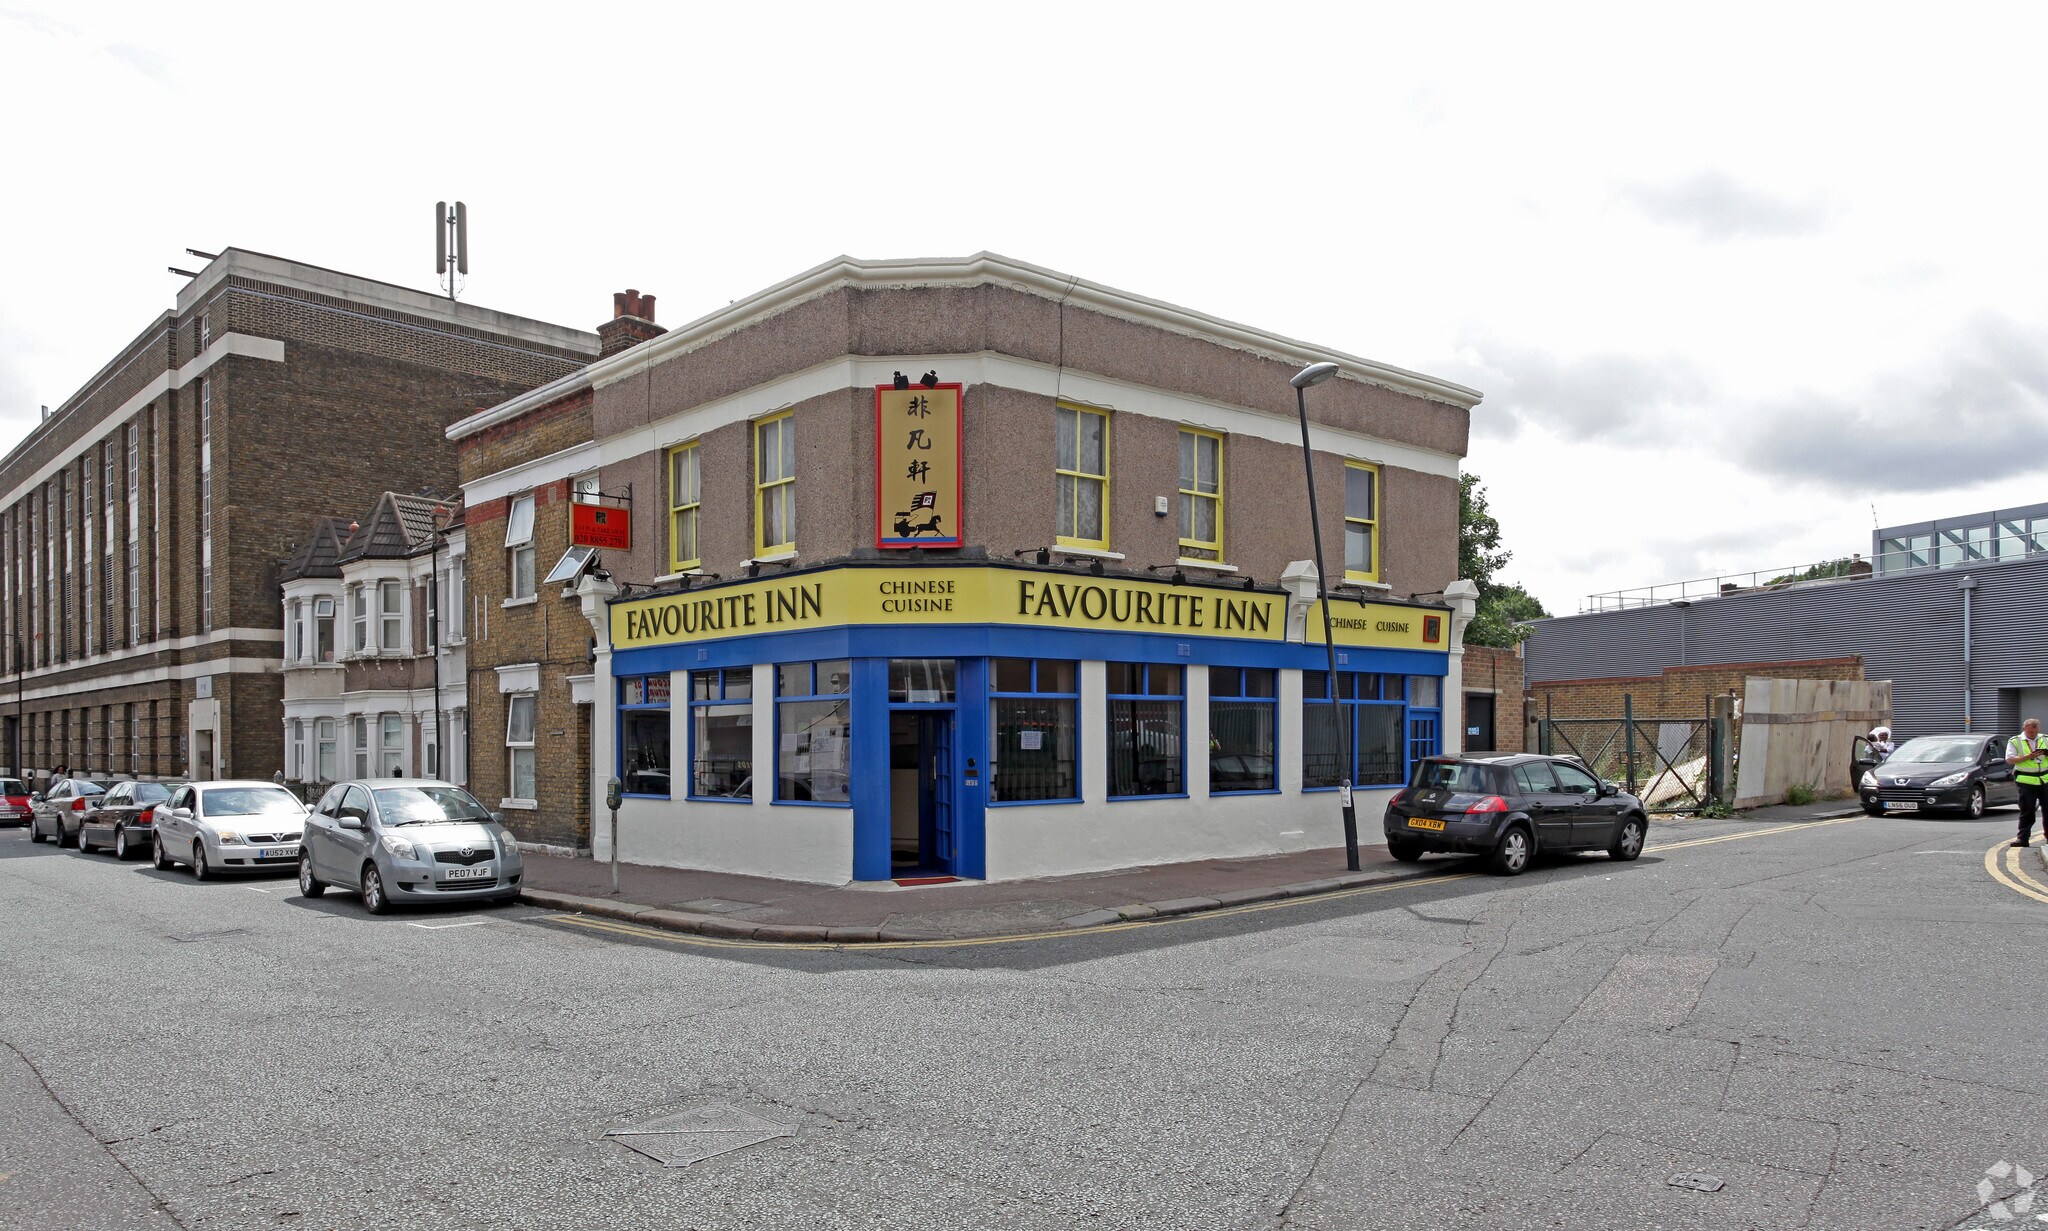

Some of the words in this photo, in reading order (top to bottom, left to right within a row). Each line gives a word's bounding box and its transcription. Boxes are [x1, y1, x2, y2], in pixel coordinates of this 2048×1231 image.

[907, 395, 931, 484] 非凡軒
[574, 533, 588, 543] 020
[590, 534, 608, 544] 8855
[880, 580, 955, 594] CHINESE
[626, 592, 757, 640] FAVOURITE
[765, 583, 822, 624] INN
[882, 598, 953, 612] CUISINE
[1018, 579, 1204, 627] FAVOURITE
[1214, 597, 1272, 632] INN
[1330, 617, 1367, 630] CHINESE
[1376, 620, 1410, 633] CUISINE
[1410, 818, 1427, 827] GX04
[265, 849, 284, 857] AU52
[449, 869, 471, 878] PE07
[472, 868, 488, 876] VJF
